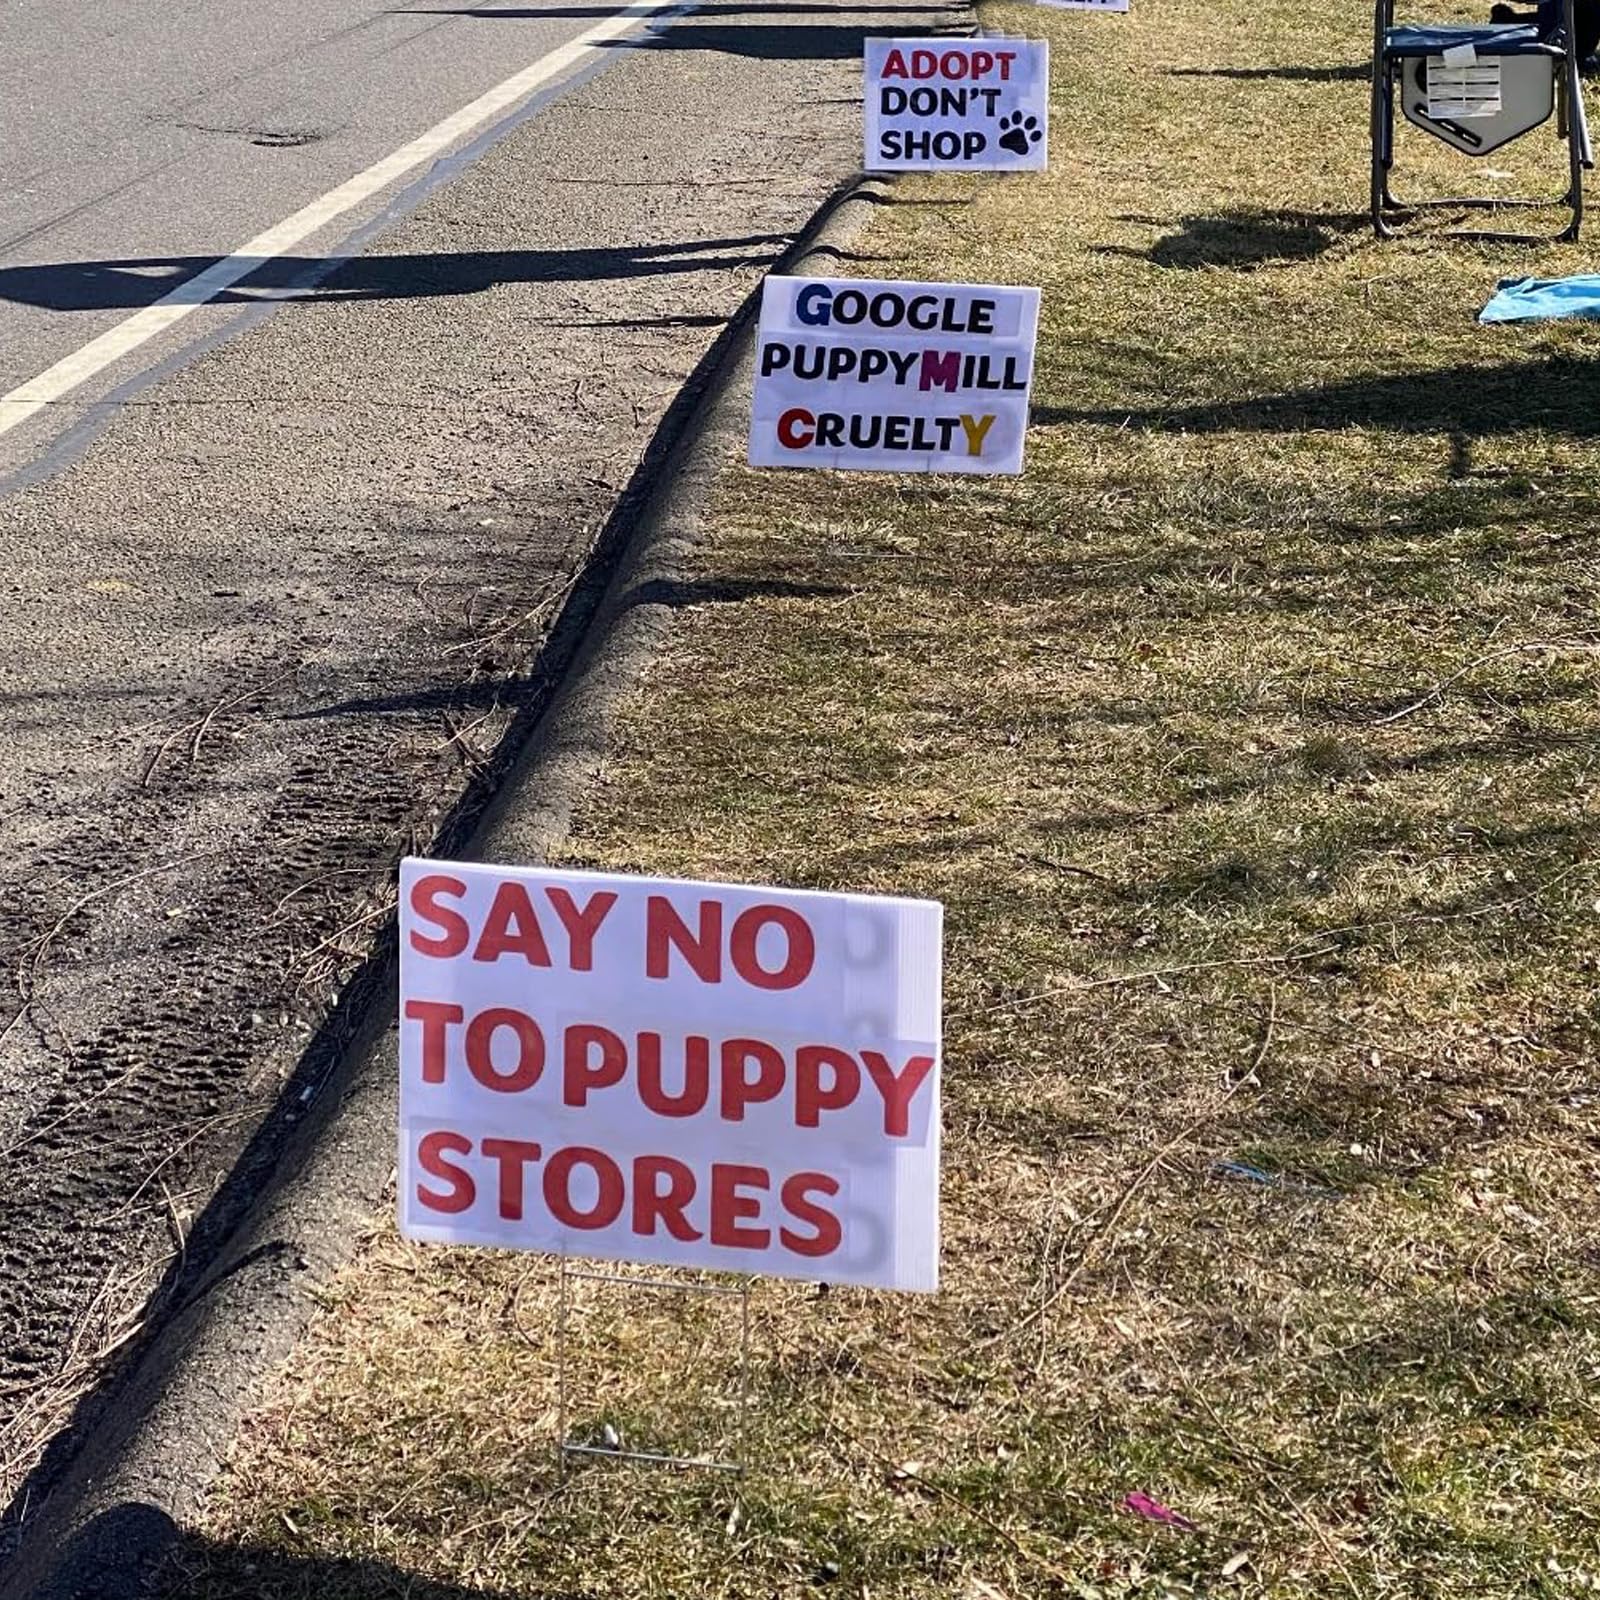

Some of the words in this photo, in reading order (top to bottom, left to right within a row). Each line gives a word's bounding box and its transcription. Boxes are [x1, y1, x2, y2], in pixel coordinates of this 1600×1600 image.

[881, 49, 1016, 80] ADOPT
[880, 130, 987, 160] SHOP
[796, 283, 996, 334] GOOGLE
[777, 408, 997, 457] CRUELTY
[409, 875, 619, 971] SAY
[645, 895, 816, 990] NO
[404, 1000, 546, 1093] TO
[563, 1024, 935, 1137] PUPPY
[416, 1131, 842, 1257] STORES
